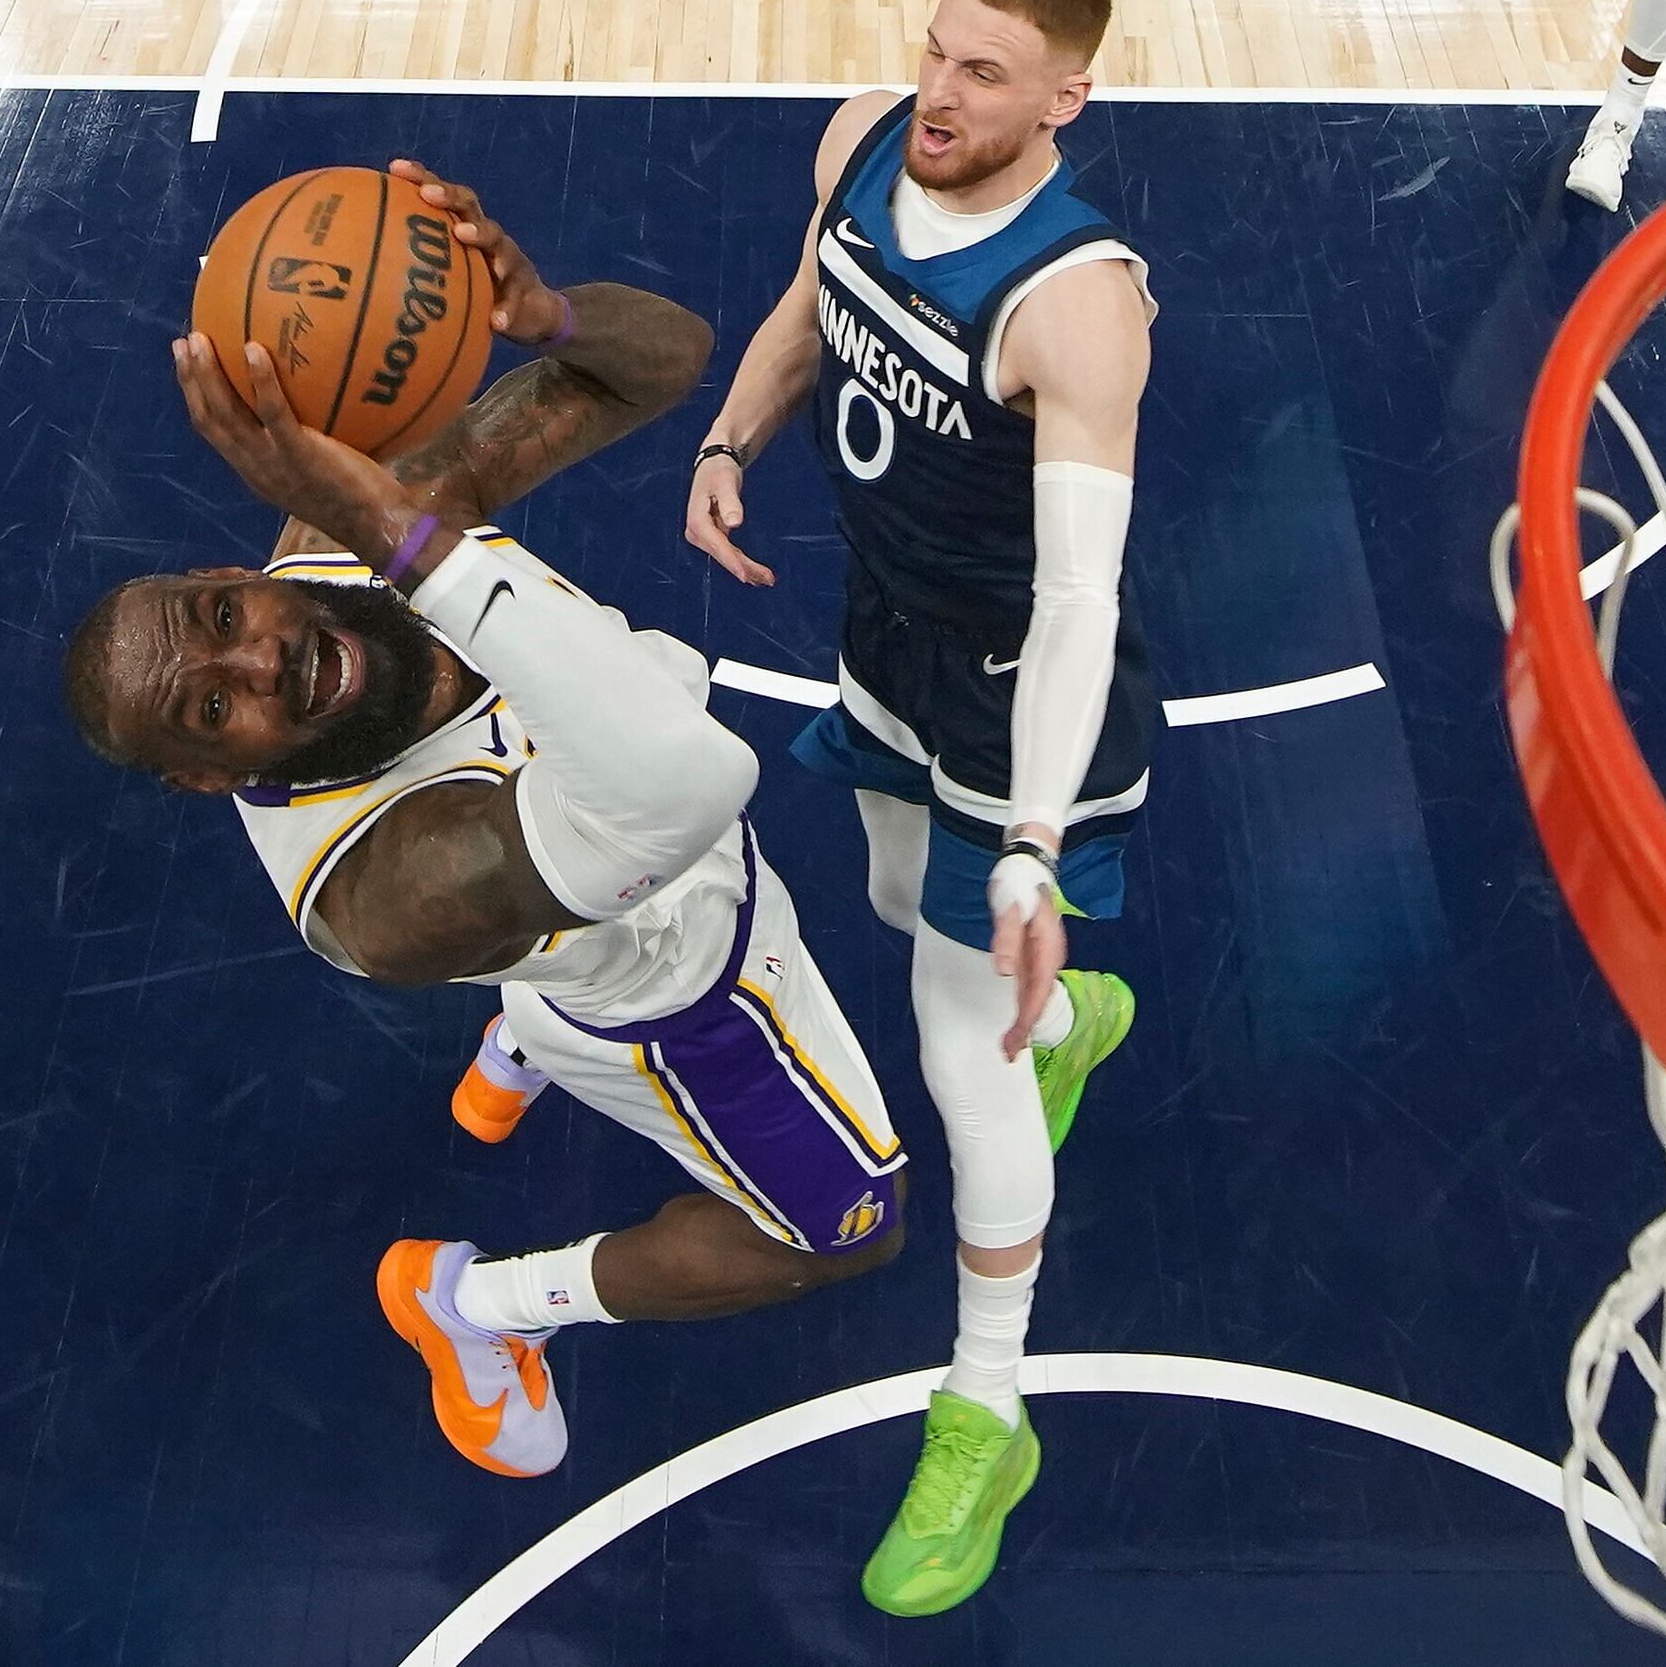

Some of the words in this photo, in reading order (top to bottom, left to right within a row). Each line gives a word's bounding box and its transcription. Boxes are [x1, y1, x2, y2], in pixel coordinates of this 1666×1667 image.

[360, 213, 452, 406] Wilson
[918, 300, 959, 338] sezzle
[836, 377, 896, 481] 0
